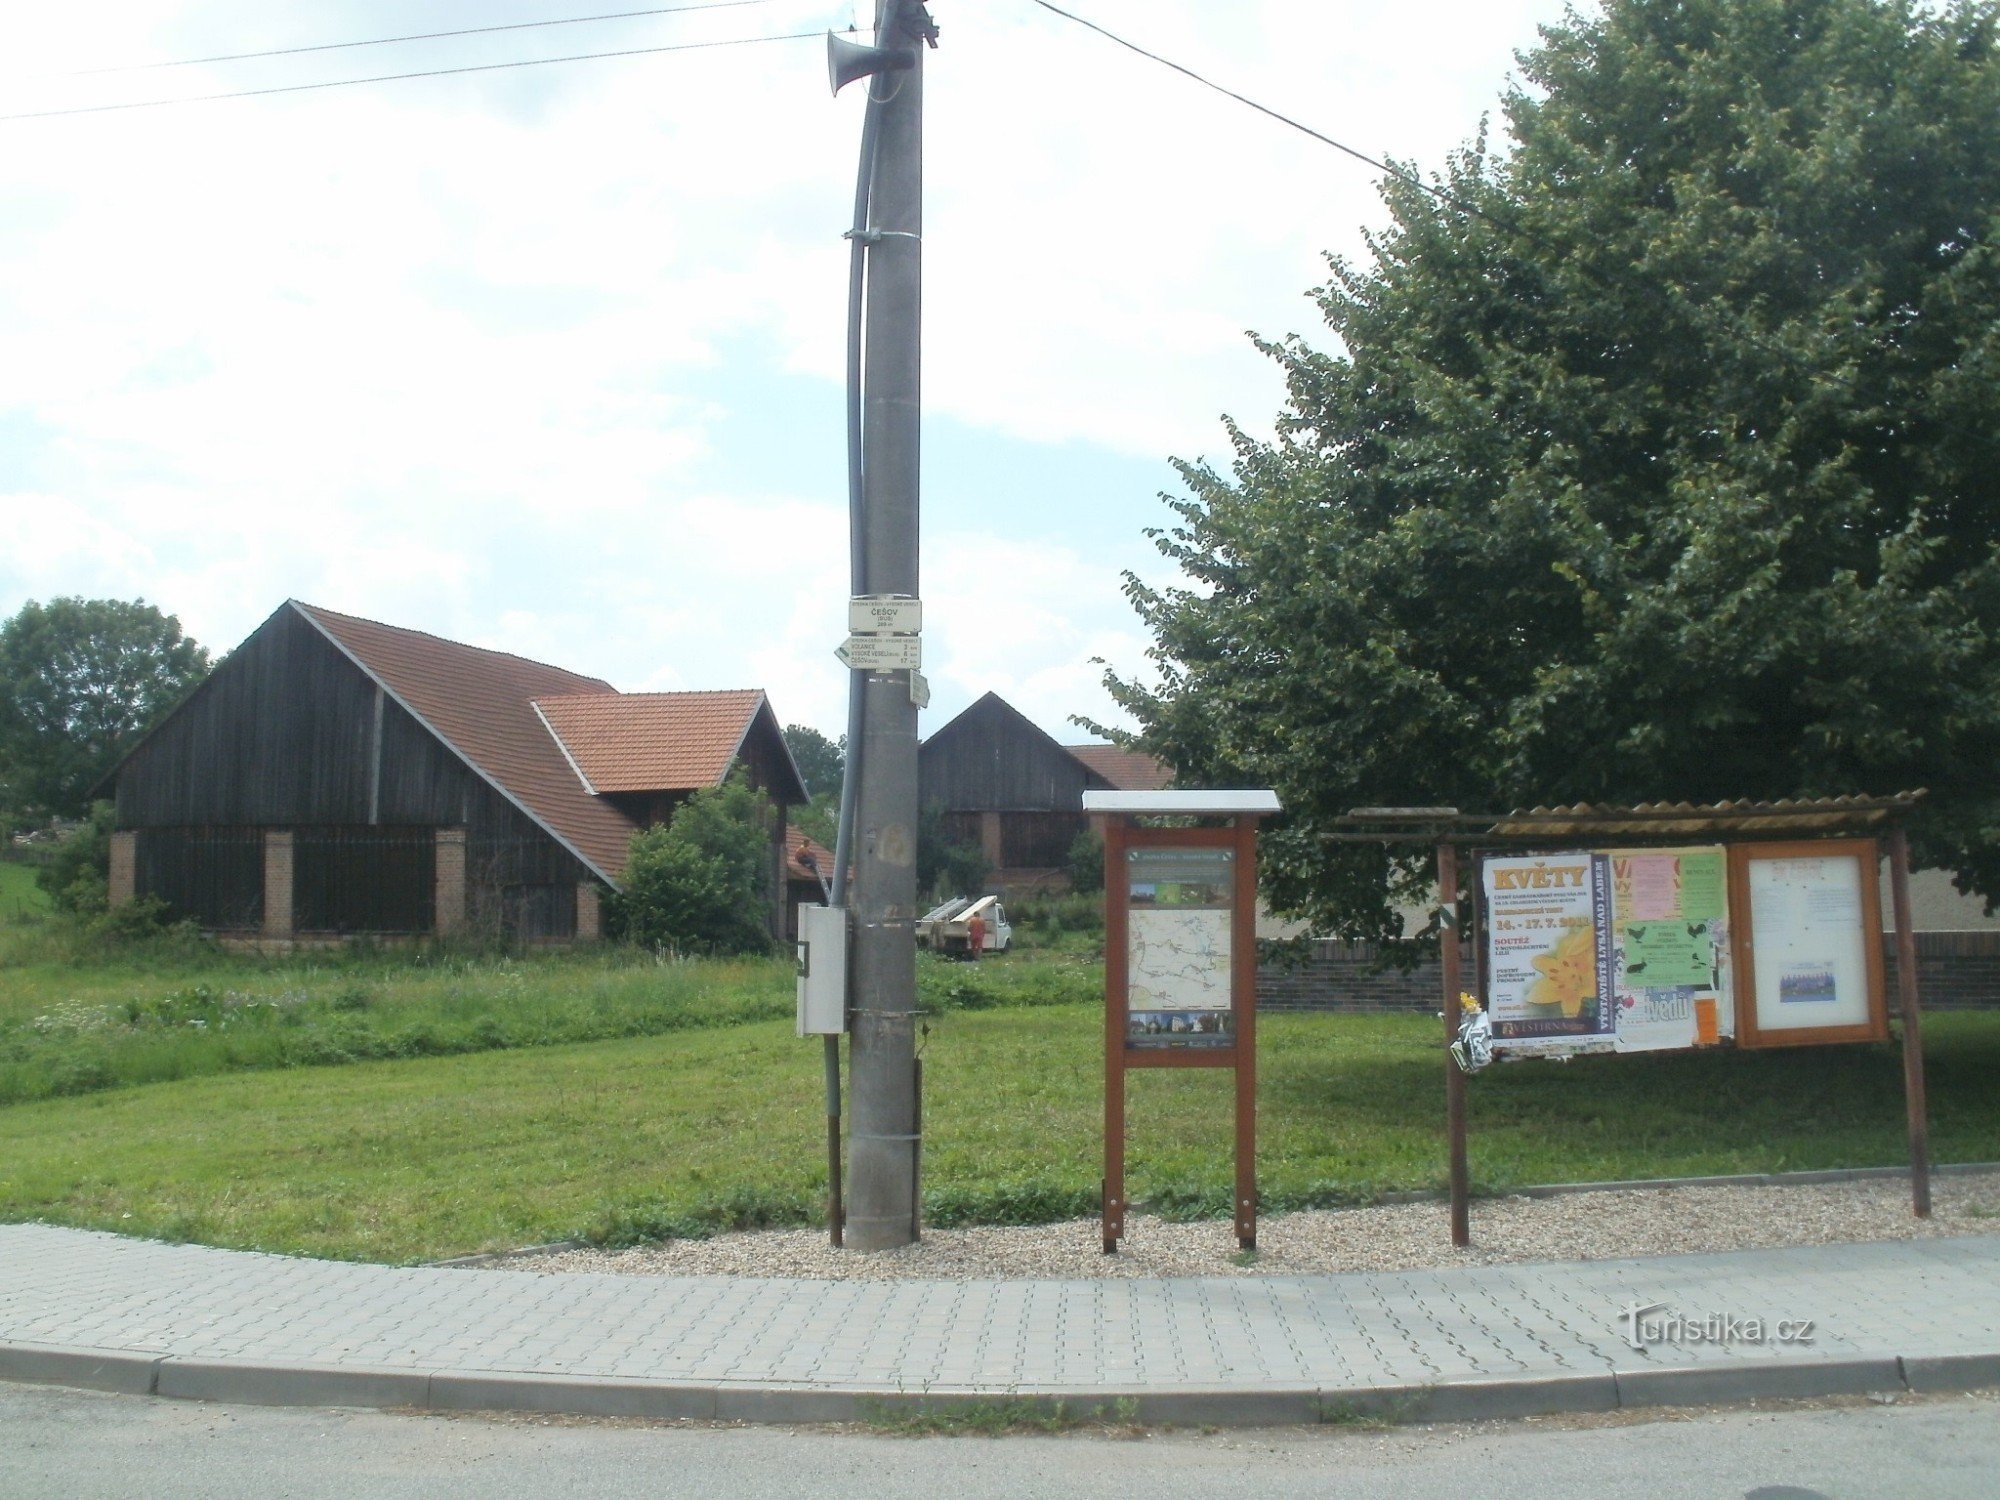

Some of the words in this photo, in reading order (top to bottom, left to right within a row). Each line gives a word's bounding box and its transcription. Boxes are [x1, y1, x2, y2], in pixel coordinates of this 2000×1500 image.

[871, 608, 898, 616] ČEŠOV
[1493, 861, 1587, 891] KVĚTY
[1594, 861, 1605, 901] LABEM
[1595, 903, 1606, 928] NAD
[1595, 930, 1607, 959] LYSÁ
